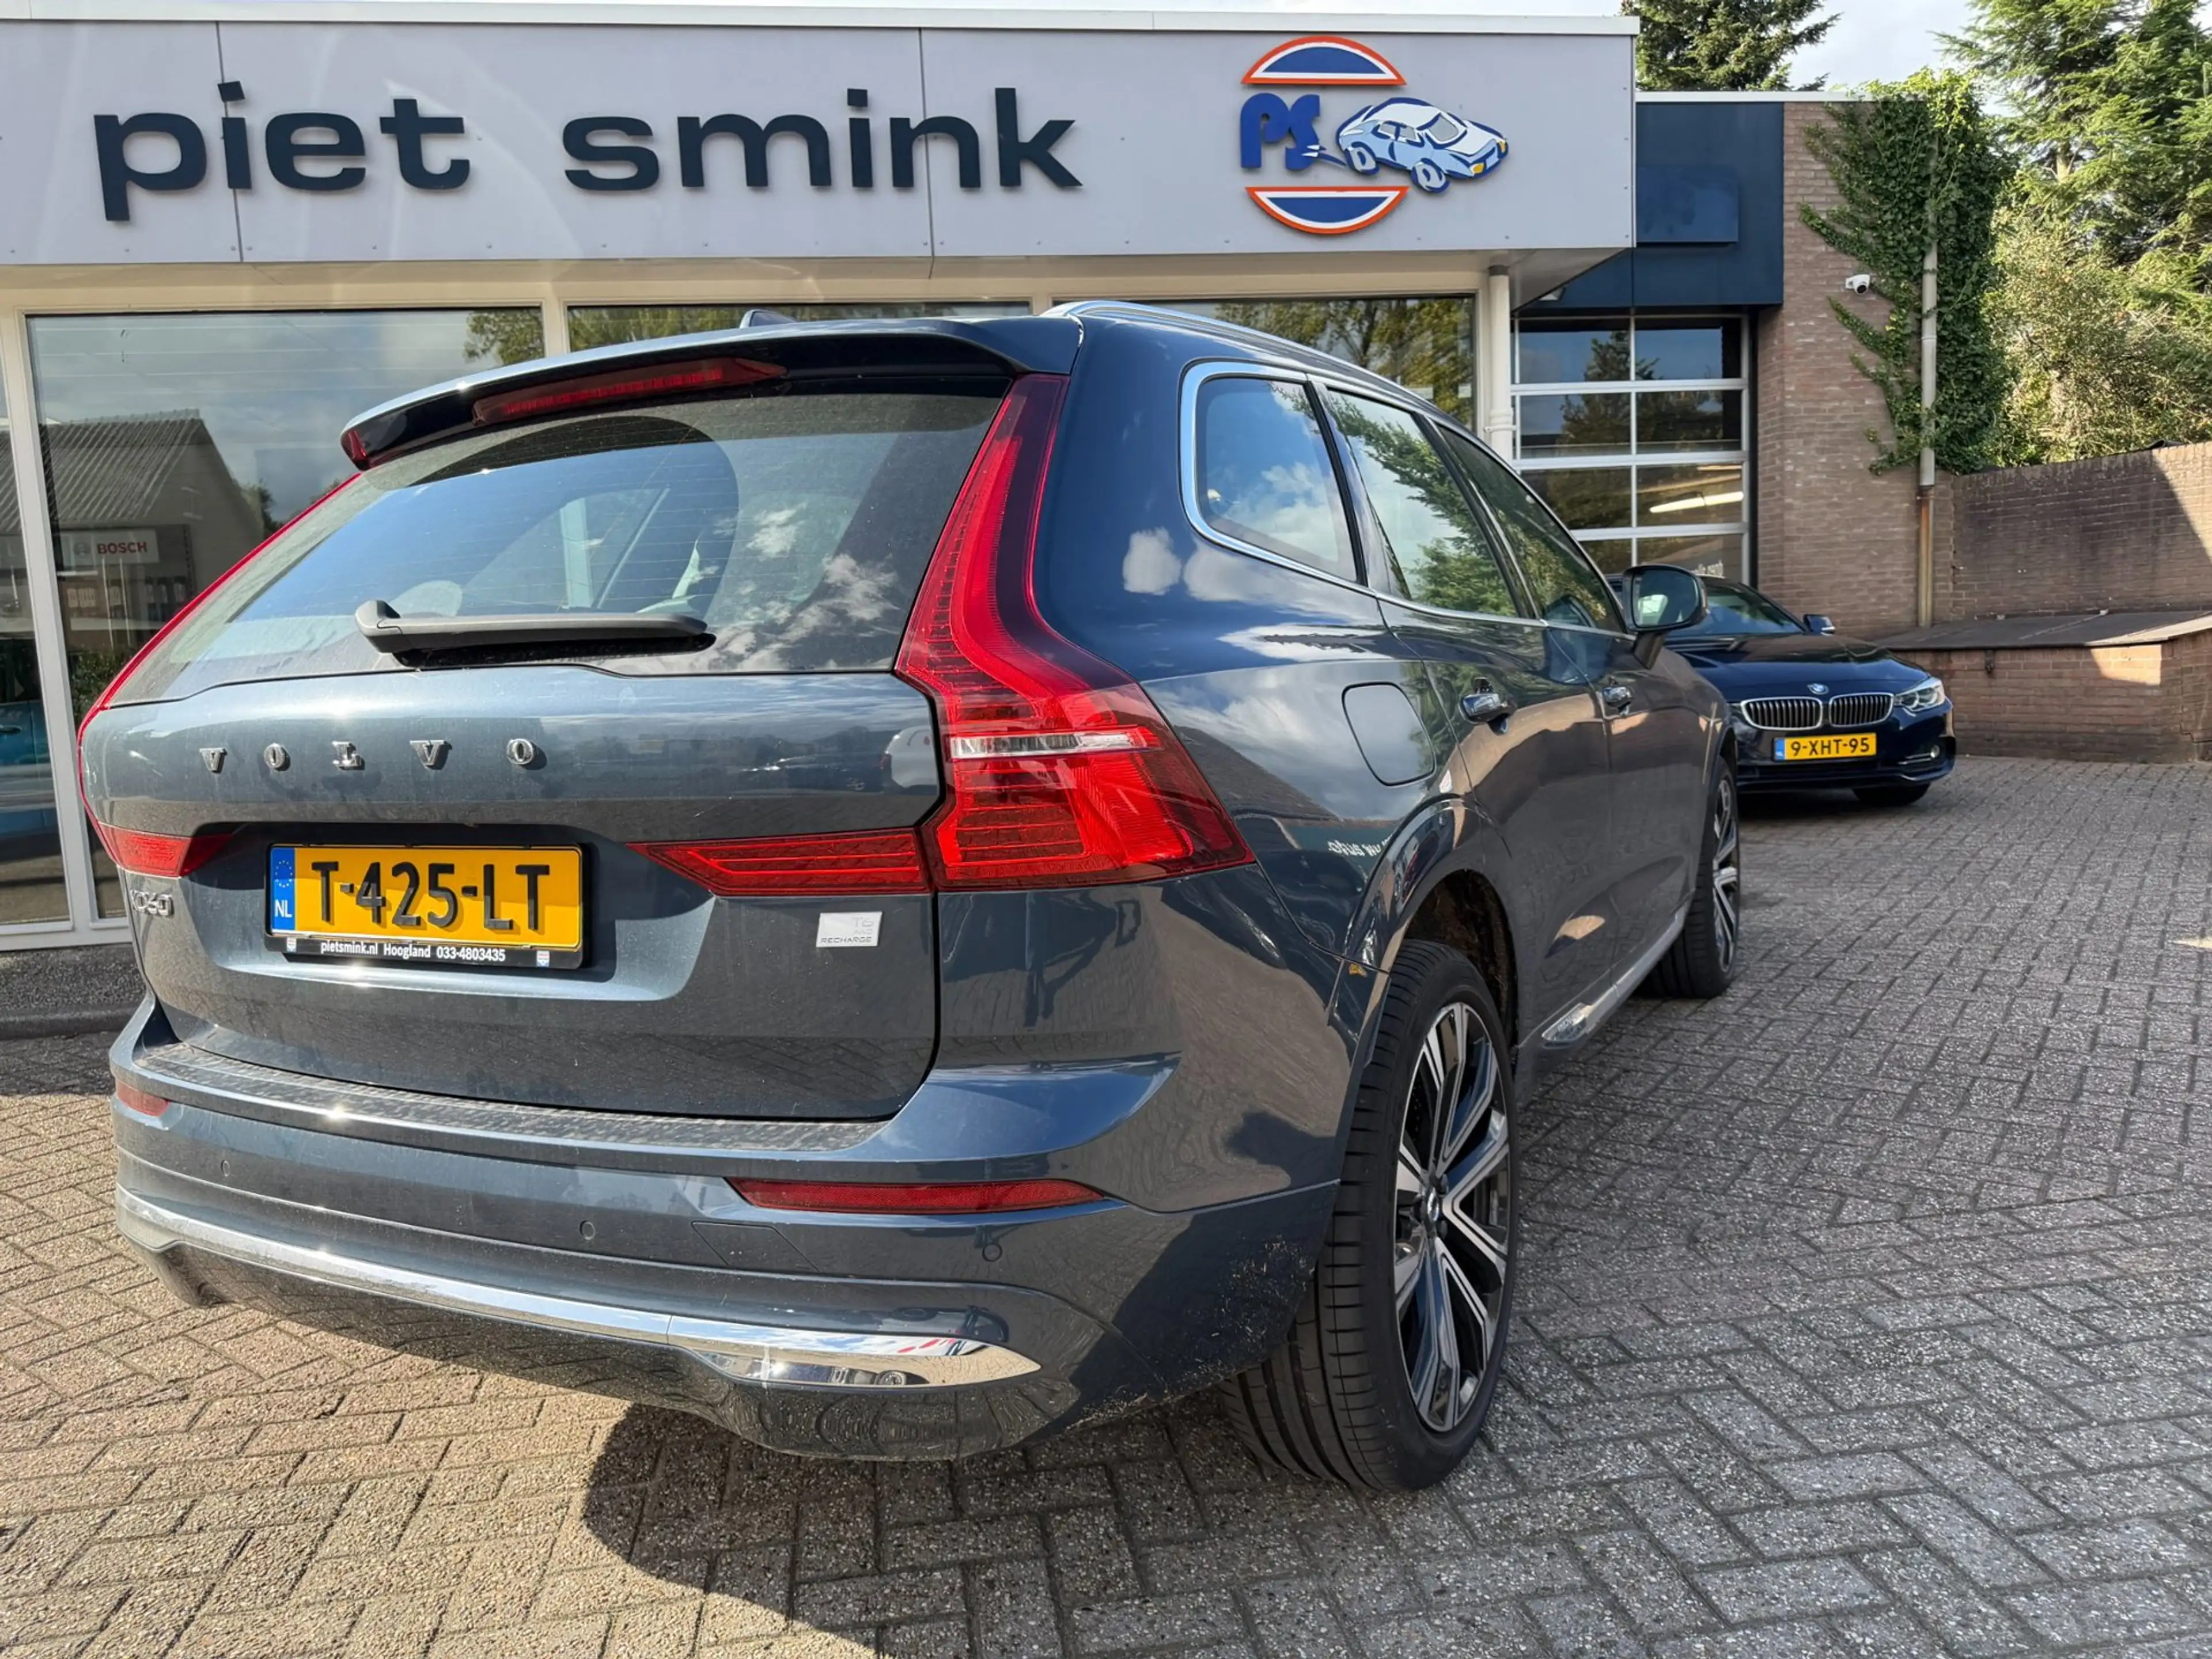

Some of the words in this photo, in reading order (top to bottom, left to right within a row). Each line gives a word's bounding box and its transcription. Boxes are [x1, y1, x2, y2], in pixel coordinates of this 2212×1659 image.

[93, 81, 471, 222] piet
[562, 88, 1084, 192] smink
[97, 541, 148, 555] BOSCH
[199, 737, 536, 774] VOLVO
[1790, 737, 1870, 756] 9-XHT-95
[312, 861, 550, 931] T-425-LT
[274, 898, 293, 919] NL
[320, 941, 378, 955] pietsmink.nl
[383, 943, 431, 961] Hoogland
[437, 946, 506, 963] 033-4803435
